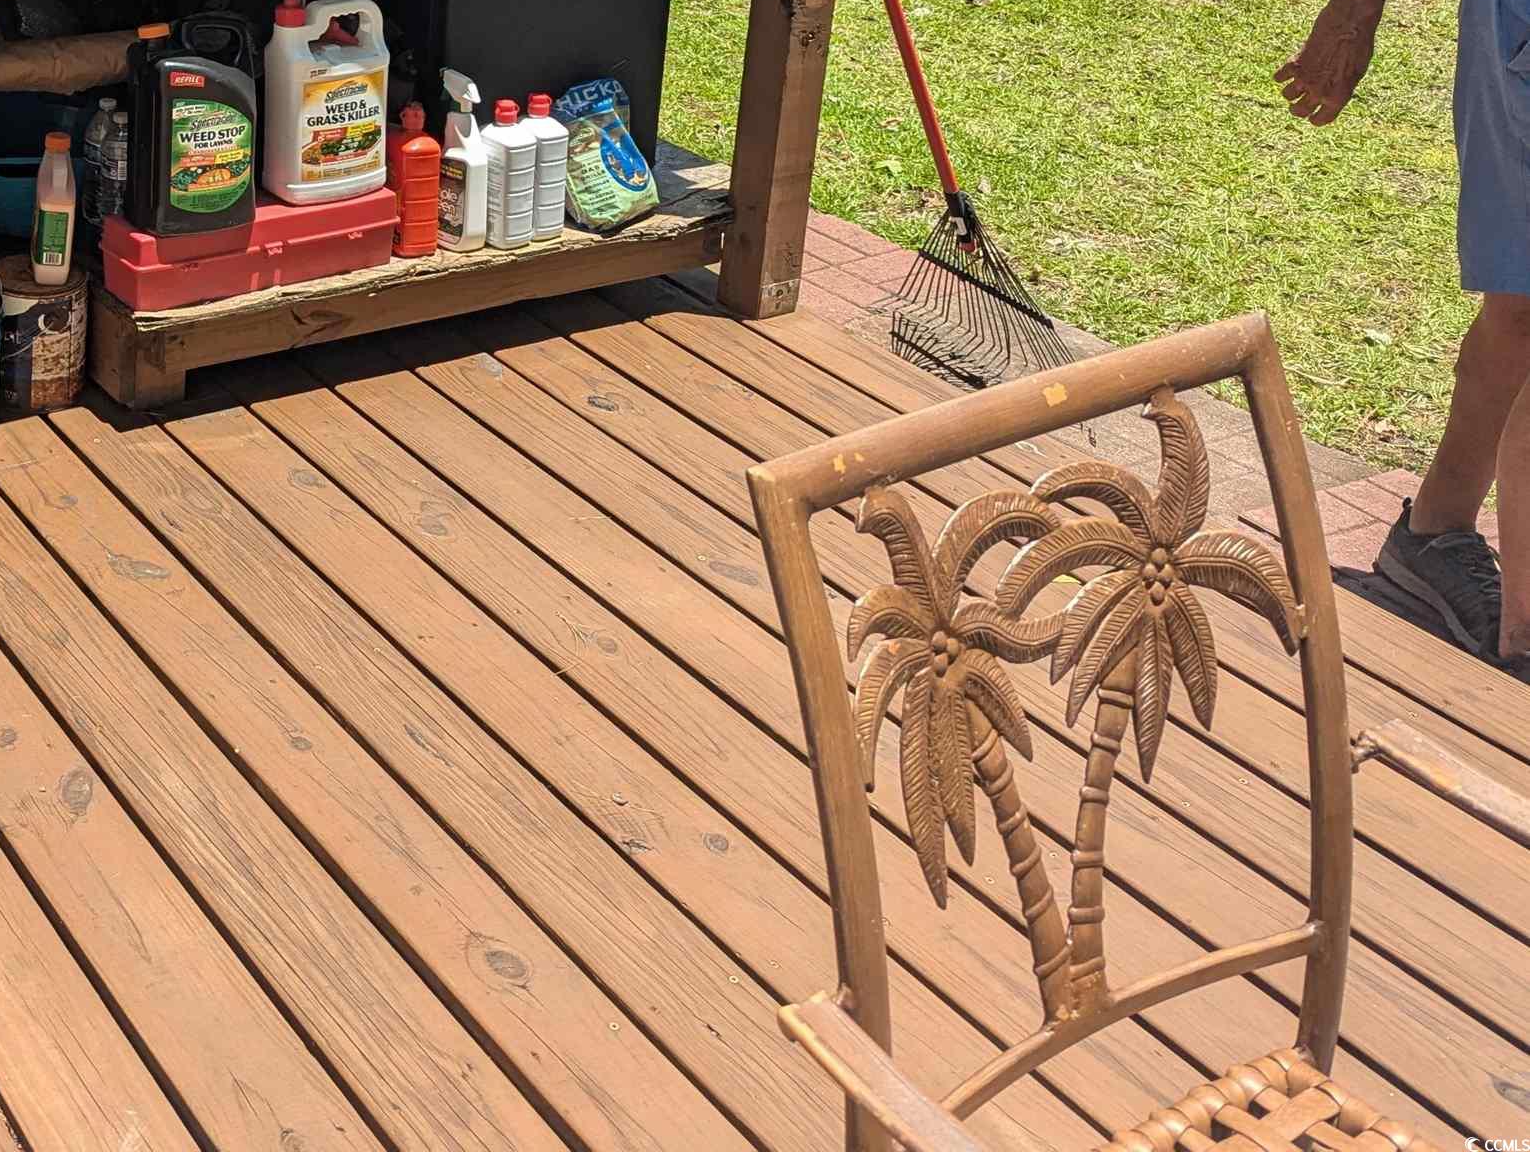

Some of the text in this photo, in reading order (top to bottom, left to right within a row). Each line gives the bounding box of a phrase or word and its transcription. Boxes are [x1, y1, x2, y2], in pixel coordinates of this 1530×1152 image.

[174, 75, 200, 84] REFILL
[325, 99, 367, 114] WEED &
[307, 106, 380, 127] GRASS KILLER
[179, 125, 246, 143] WEED STOP
[194, 139, 233, 149] FOR LAWNS
